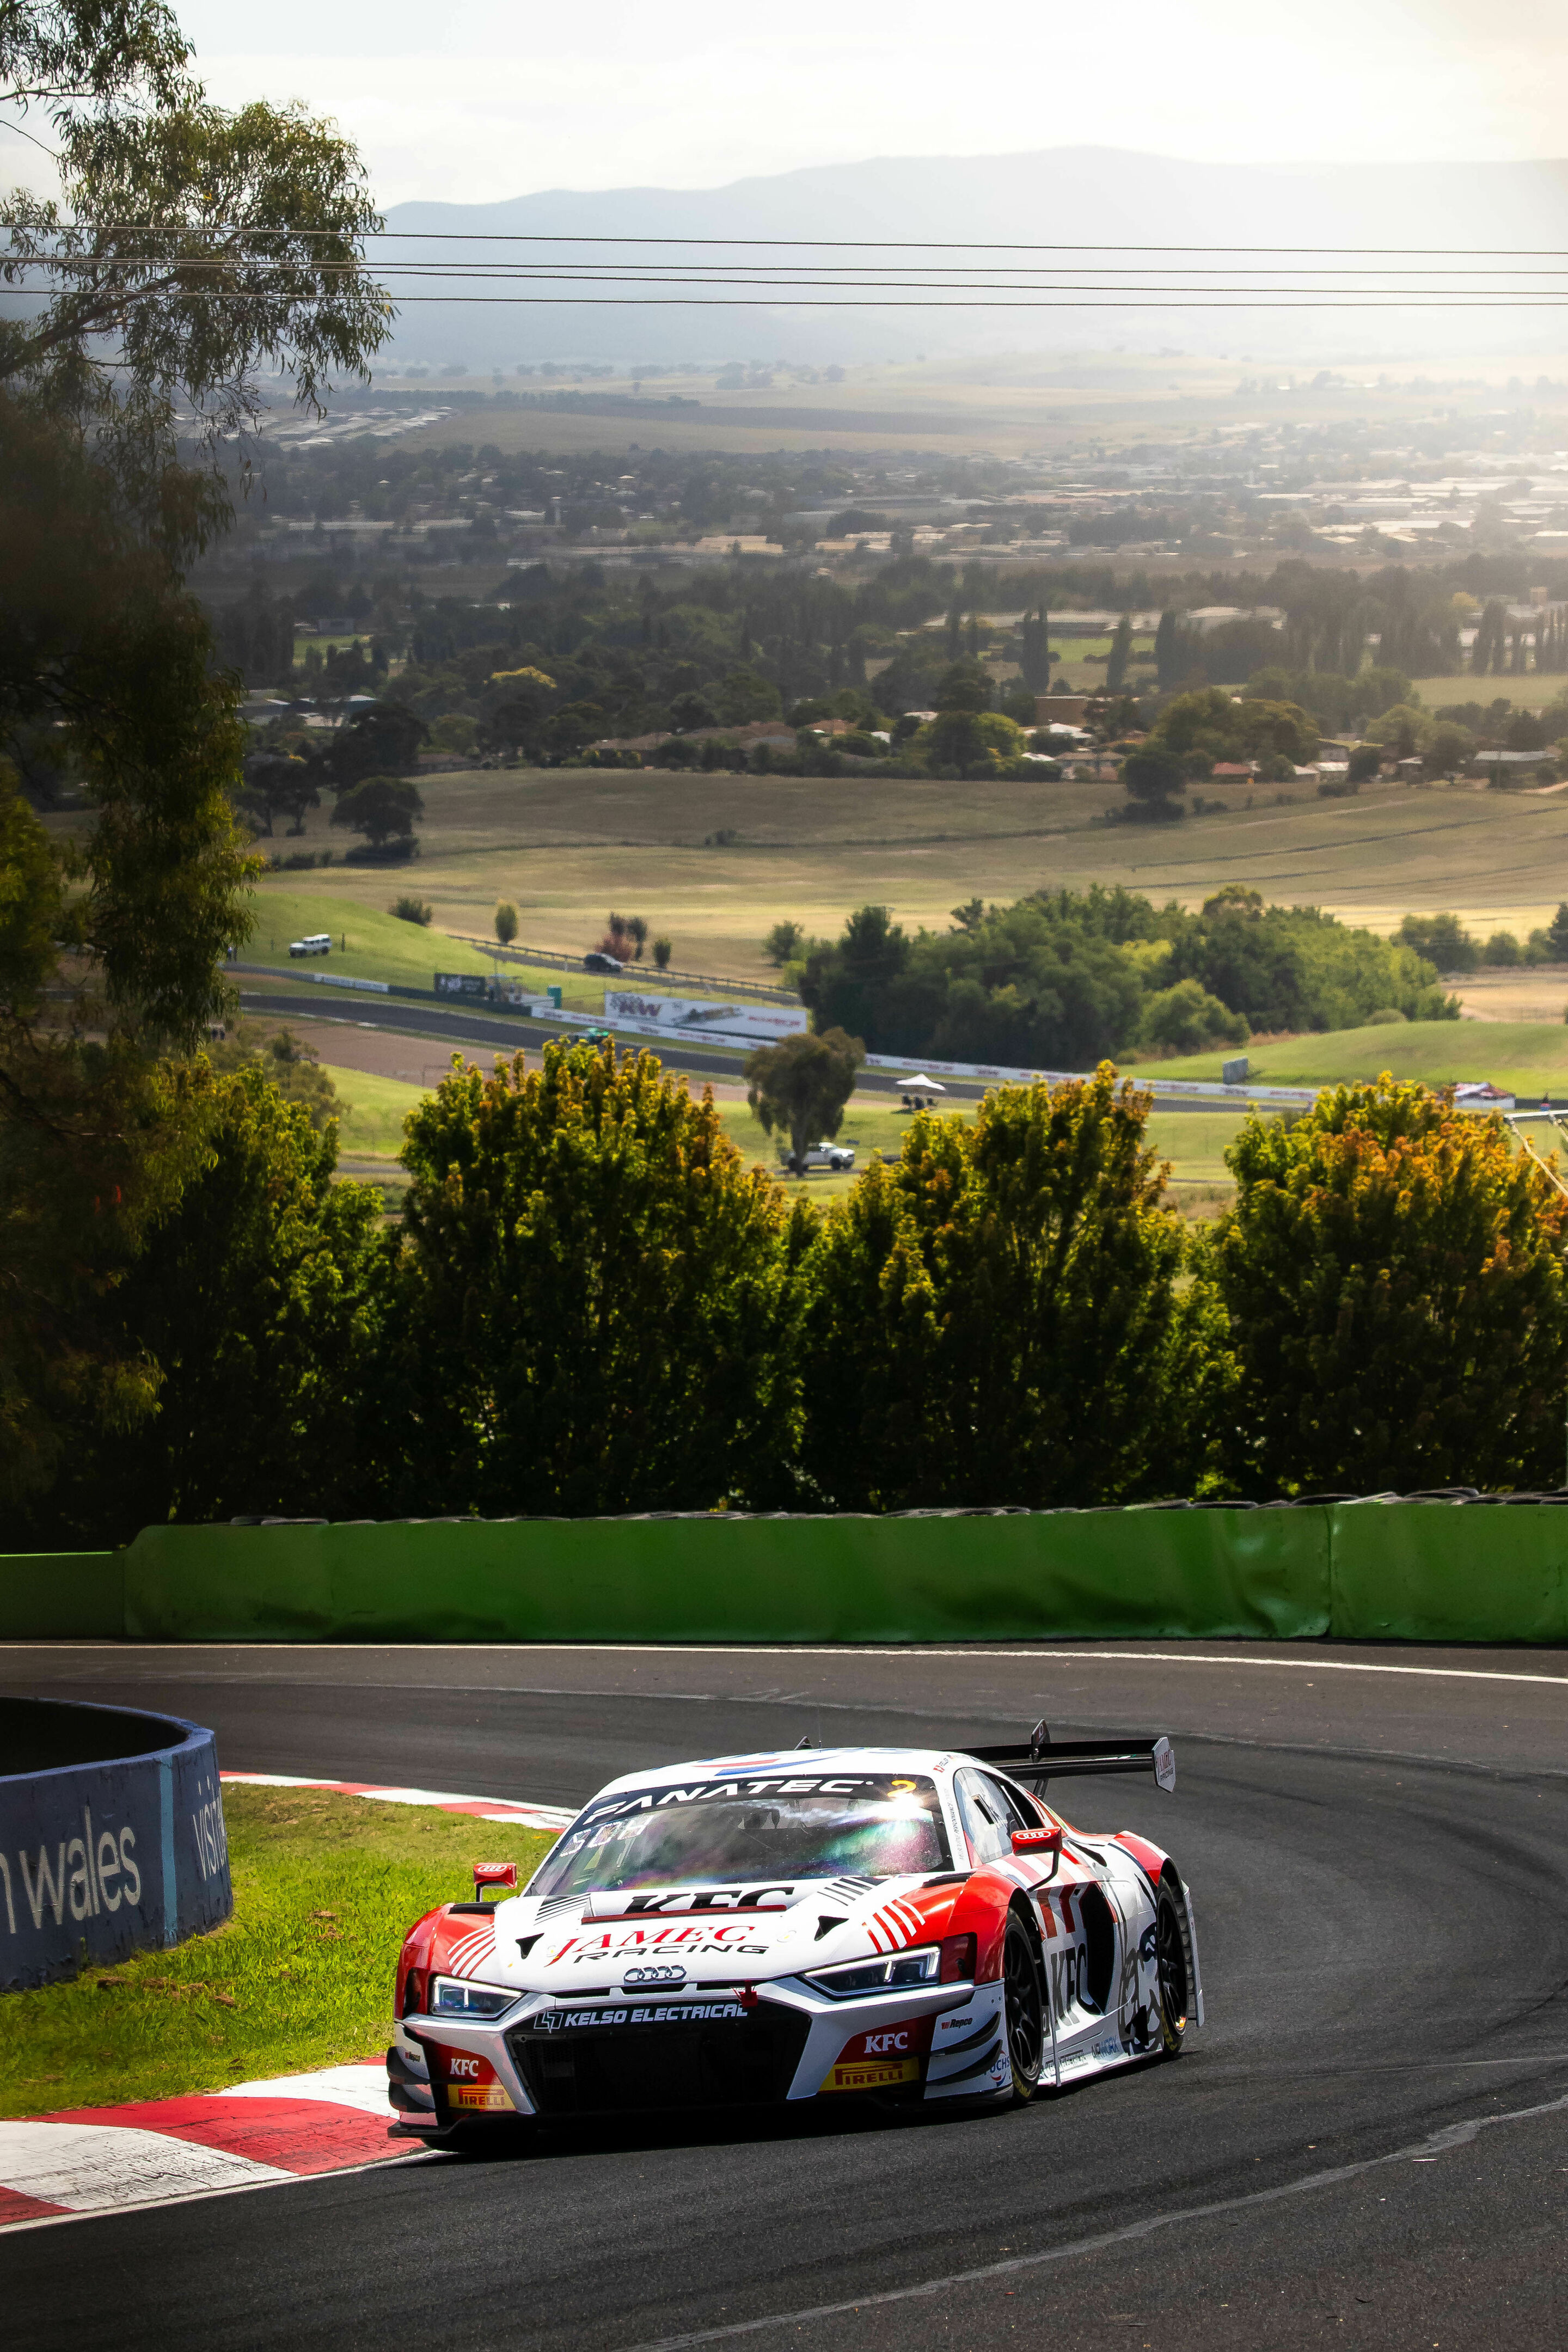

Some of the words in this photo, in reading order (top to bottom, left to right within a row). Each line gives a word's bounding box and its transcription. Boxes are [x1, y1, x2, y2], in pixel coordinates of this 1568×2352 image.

[887, 1779, 917, 1798] 2
[584, 1779, 863, 1825] FANATEC
[19, 1804, 142, 1929] wales
[543, 1925, 756, 1967] JAMEC
[573, 1944, 770, 1964] RACING
[564, 2010, 628, 2027] KELSO
[630, 2004, 748, 2023] ELECTRICAL
[949, 2017, 973, 2029] Repco
[863, 2031, 908, 2054] KFC
[450, 2057, 479, 2077] KFC
[834, 2062, 903, 2086] PIRELLI
[457, 2087, 505, 2106] PIRELLI
